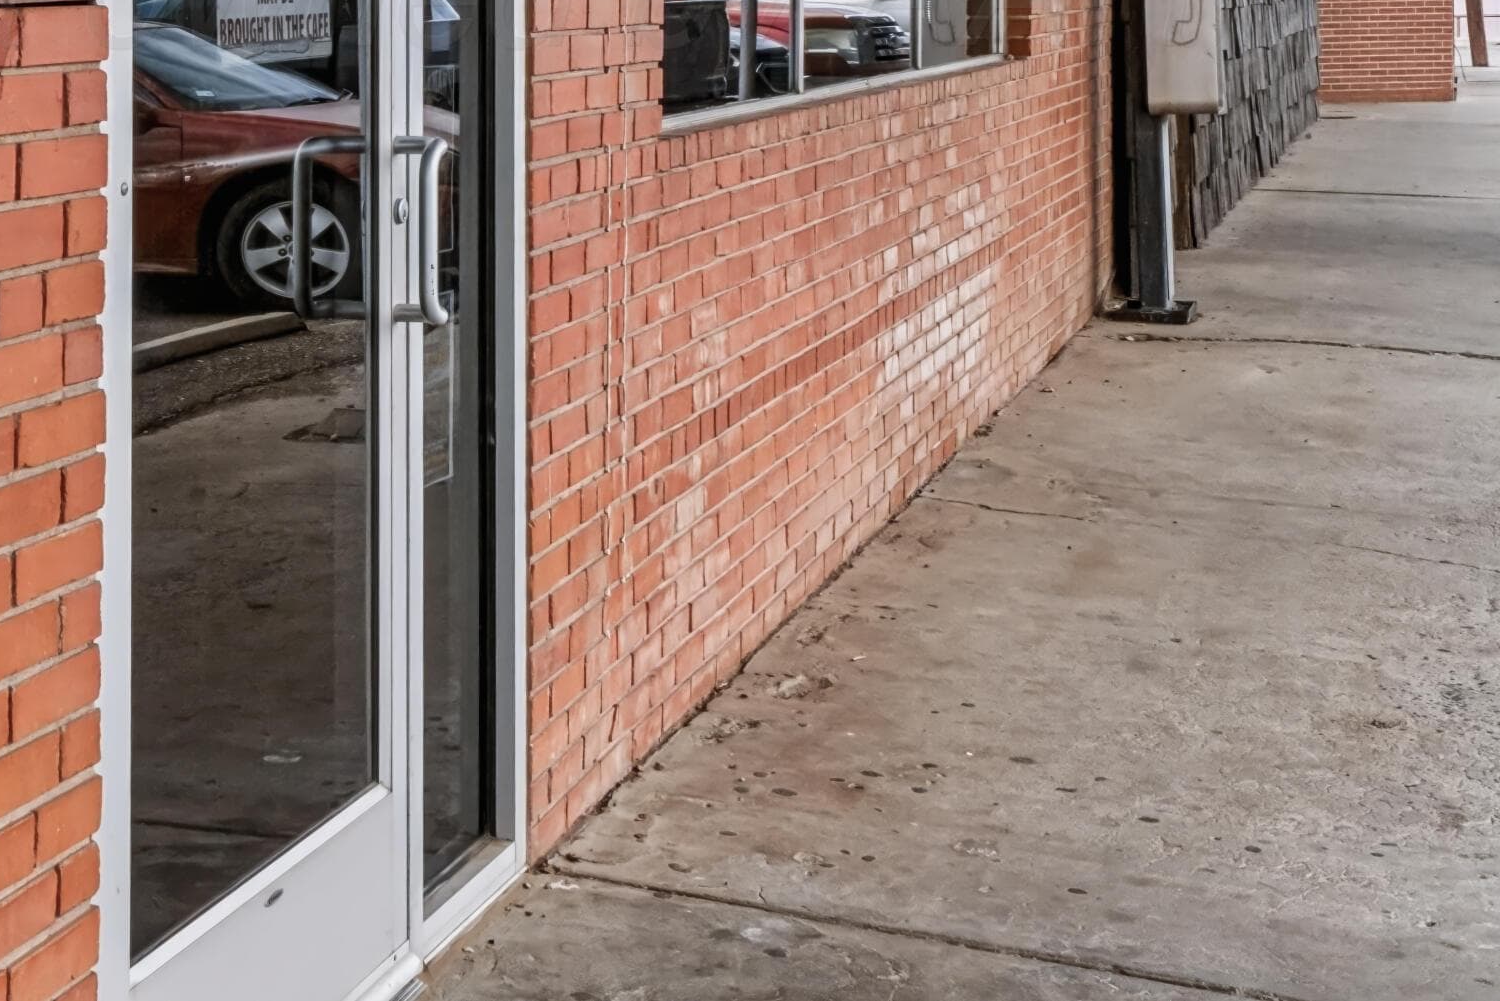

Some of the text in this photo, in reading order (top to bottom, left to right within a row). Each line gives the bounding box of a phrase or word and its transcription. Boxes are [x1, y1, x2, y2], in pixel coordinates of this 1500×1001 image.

[219, 12, 330, 45] BROUGHT IN THE CAFE
